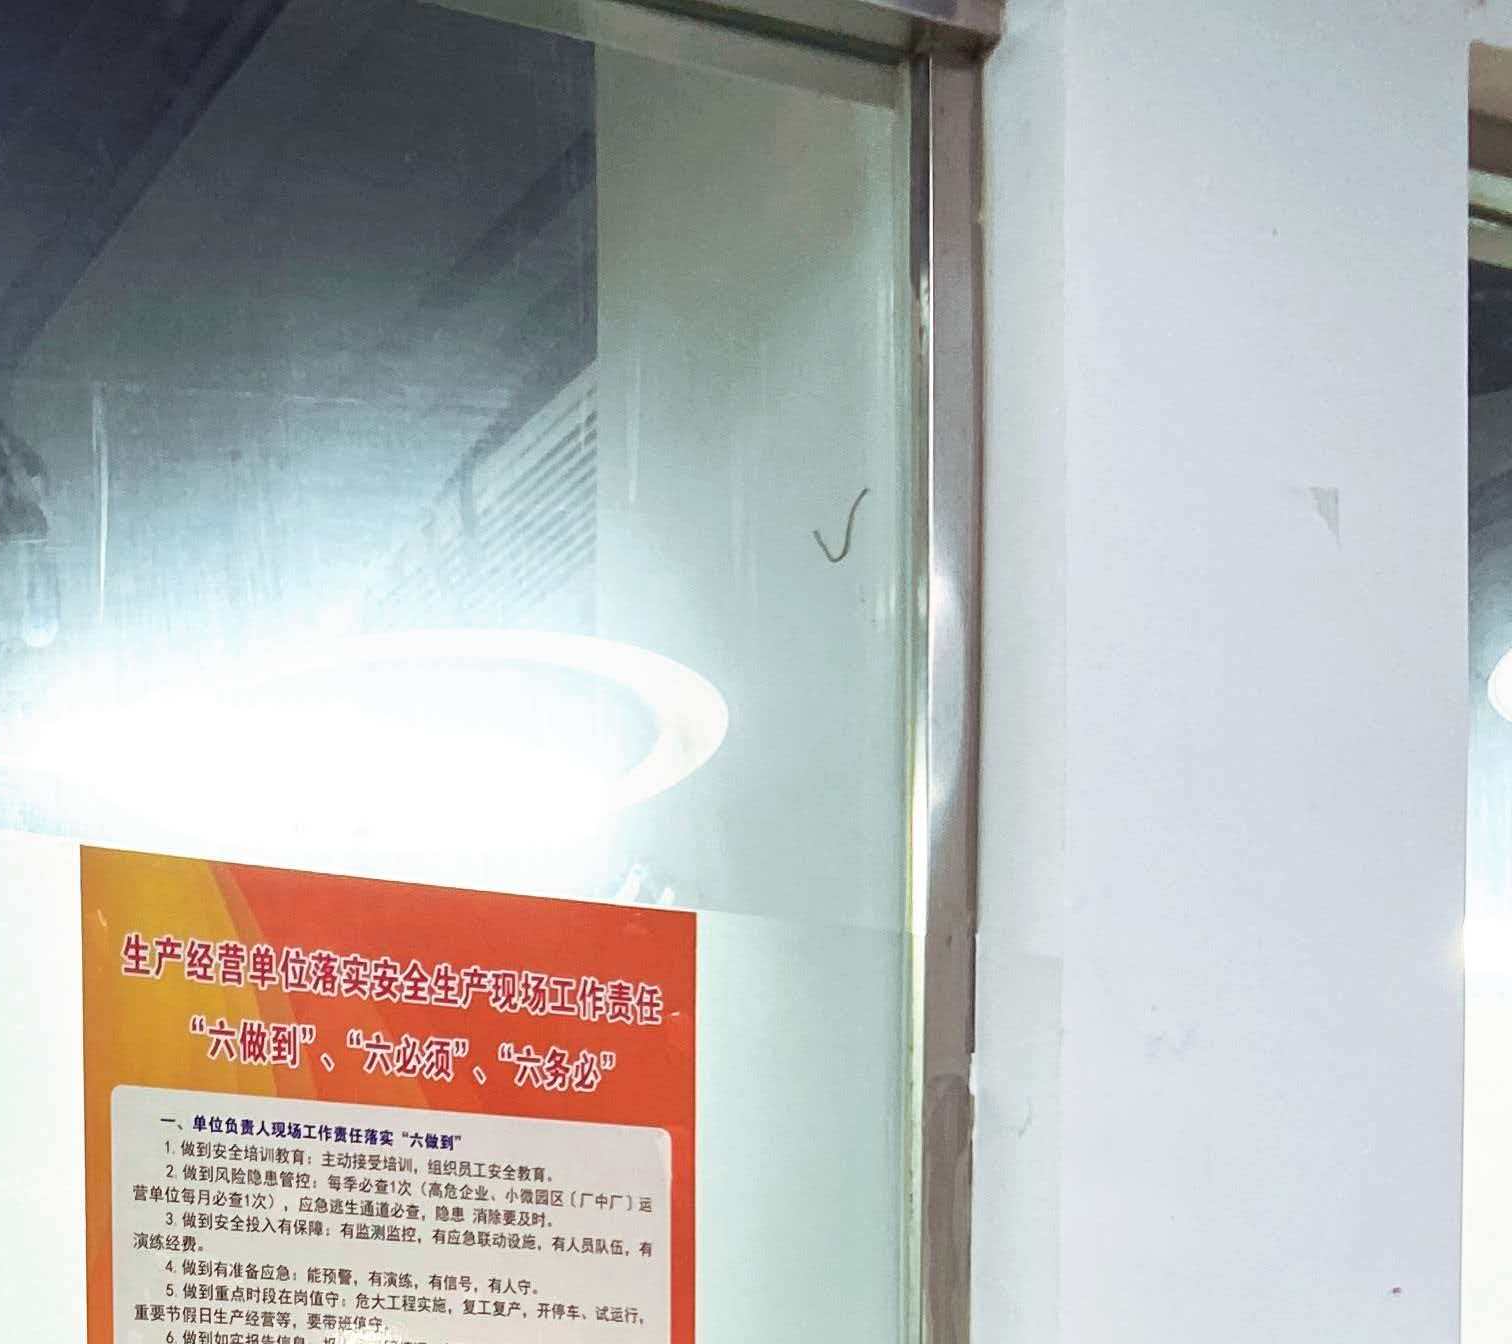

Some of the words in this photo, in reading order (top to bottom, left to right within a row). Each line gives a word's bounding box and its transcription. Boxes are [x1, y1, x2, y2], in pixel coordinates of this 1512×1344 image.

[123, 932, 662, 1024] 生产经营单位落实安全生产现场工作责任
[133, 1231, 204, 1252] 演练经费。
